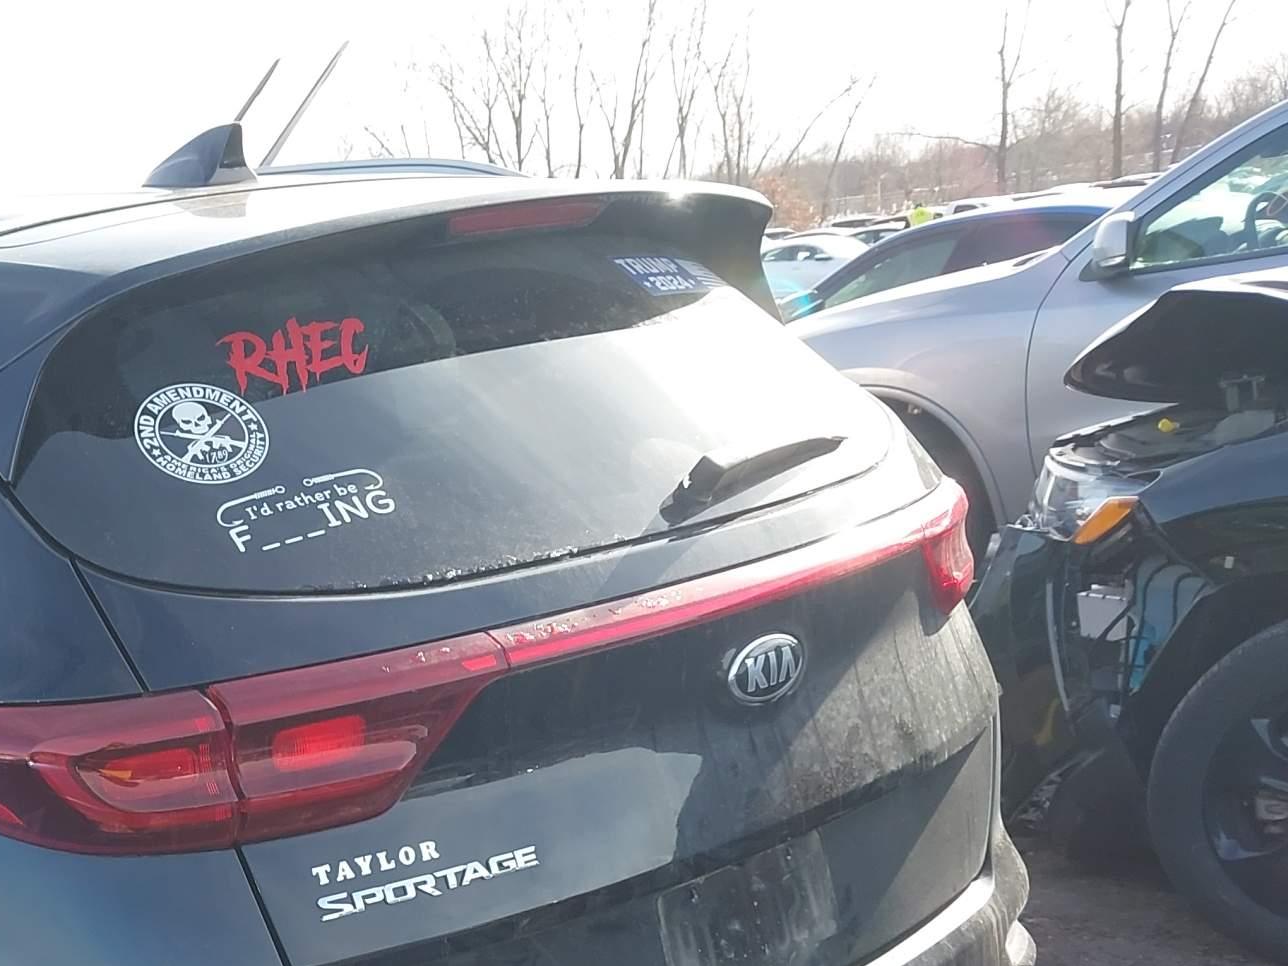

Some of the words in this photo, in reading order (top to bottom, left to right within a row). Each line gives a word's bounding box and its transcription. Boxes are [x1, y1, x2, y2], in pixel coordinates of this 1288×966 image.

[614, 257, 678, 274] TRUMP
[648, 275, 693, 290] 2024
[146, 386, 257, 421] AMENDMENT
[139, 415, 160, 449] 2ND
[156, 457, 231, 480] HOMELAND
[233, 432, 265, 475] SECURITY
[163, 455, 227, 473] AMERICA'S
[230, 432, 256, 469] ORIGINAL
[245, 503, 274, 521] I'd
[275, 490, 332, 514] rather
[337, 483, 358, 497] be
[744, 646, 796, 692] KIA
[311, 841, 440, 885] TAYLOR
[317, 846, 540, 922] SPORTAGE
